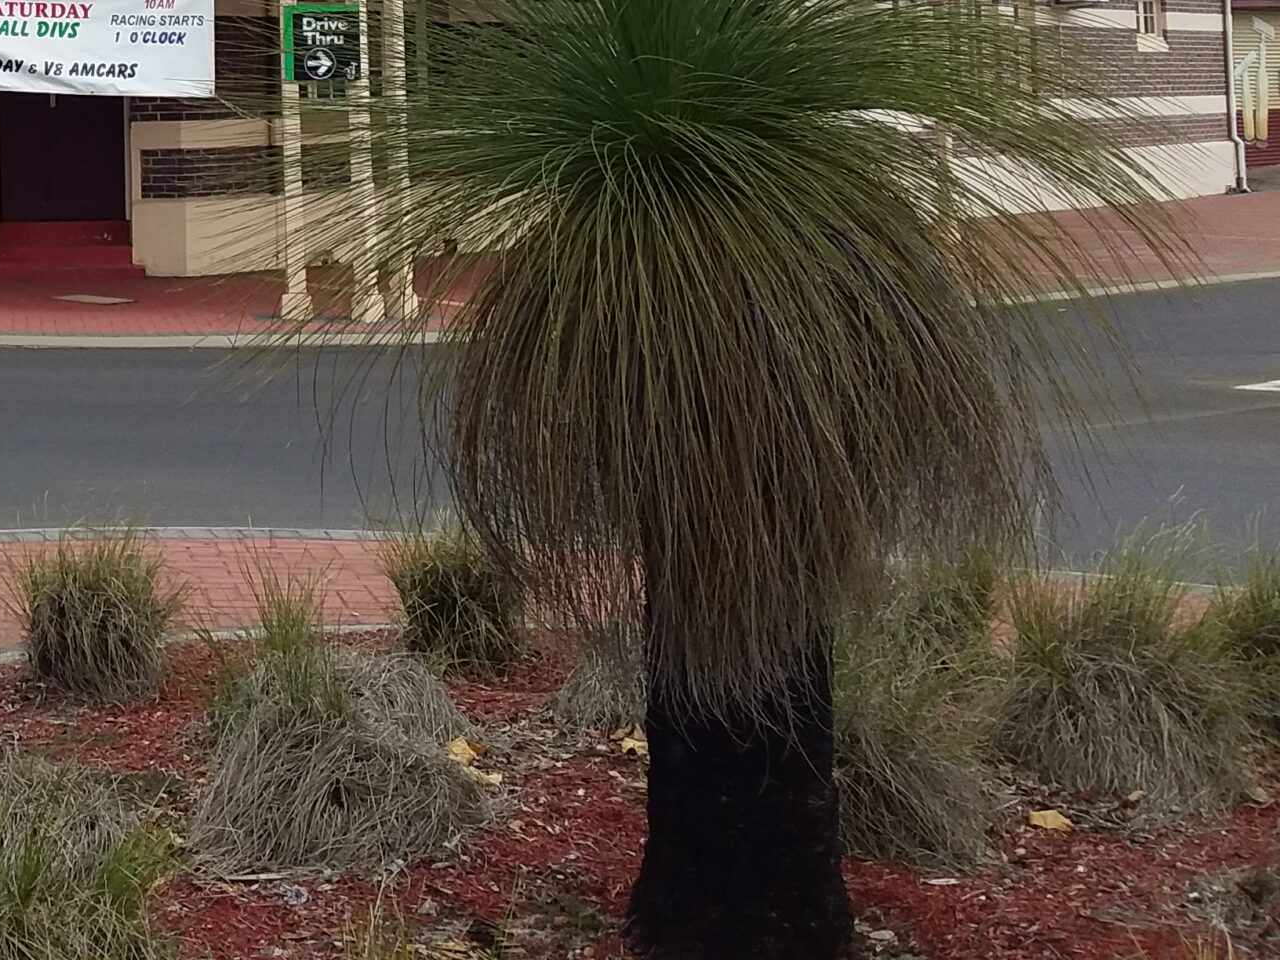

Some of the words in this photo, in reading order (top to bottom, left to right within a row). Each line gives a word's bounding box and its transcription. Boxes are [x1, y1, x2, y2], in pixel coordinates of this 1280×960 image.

[110, 14, 156, 26] RACING
[159, 15, 205, 27] STARTS
[302, 16, 348, 31] Drive
[36, 21, 80, 38] DIVS
[115, 31, 121, 43] 1
[130, 31, 187, 45] O'CLOCK
[302, 31, 345, 46] Thru
[27, 62, 38, 74] &
[44, 61, 64, 76] V8
[69, 62, 138, 80] AMCARS
